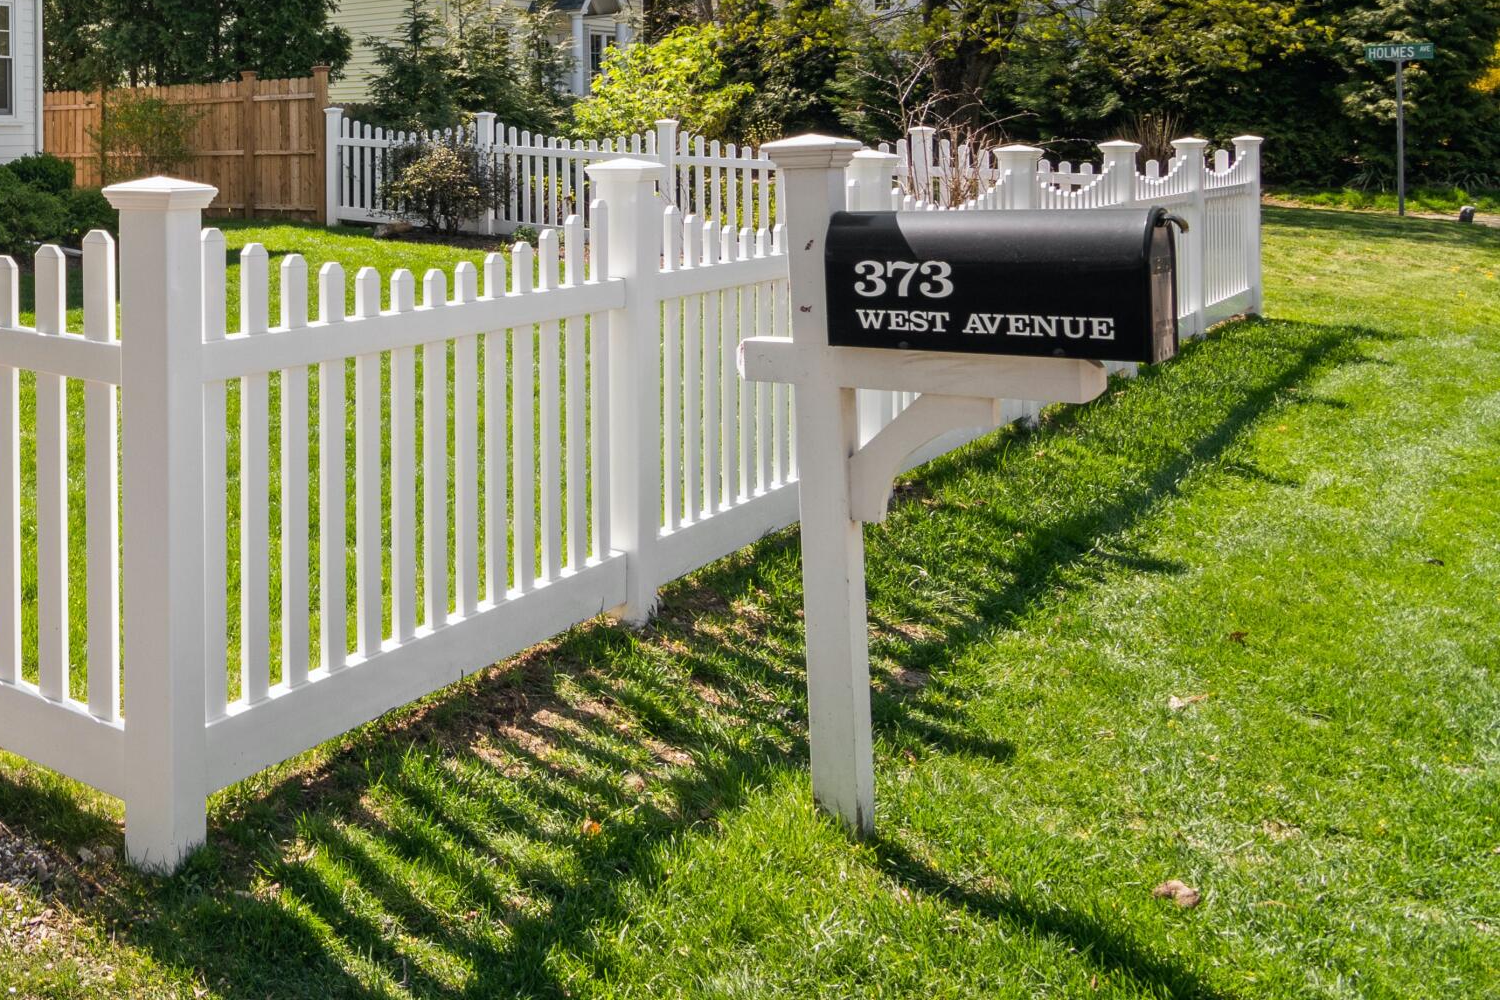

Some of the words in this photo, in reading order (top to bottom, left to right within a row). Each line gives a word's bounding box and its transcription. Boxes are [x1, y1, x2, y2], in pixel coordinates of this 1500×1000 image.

[1368, 46, 1415, 59] HOLMES
[854, 260, 954, 298] 373
[855, 309, 949, 332] WEST
[962, 313, 1115, 341] AVENUE
